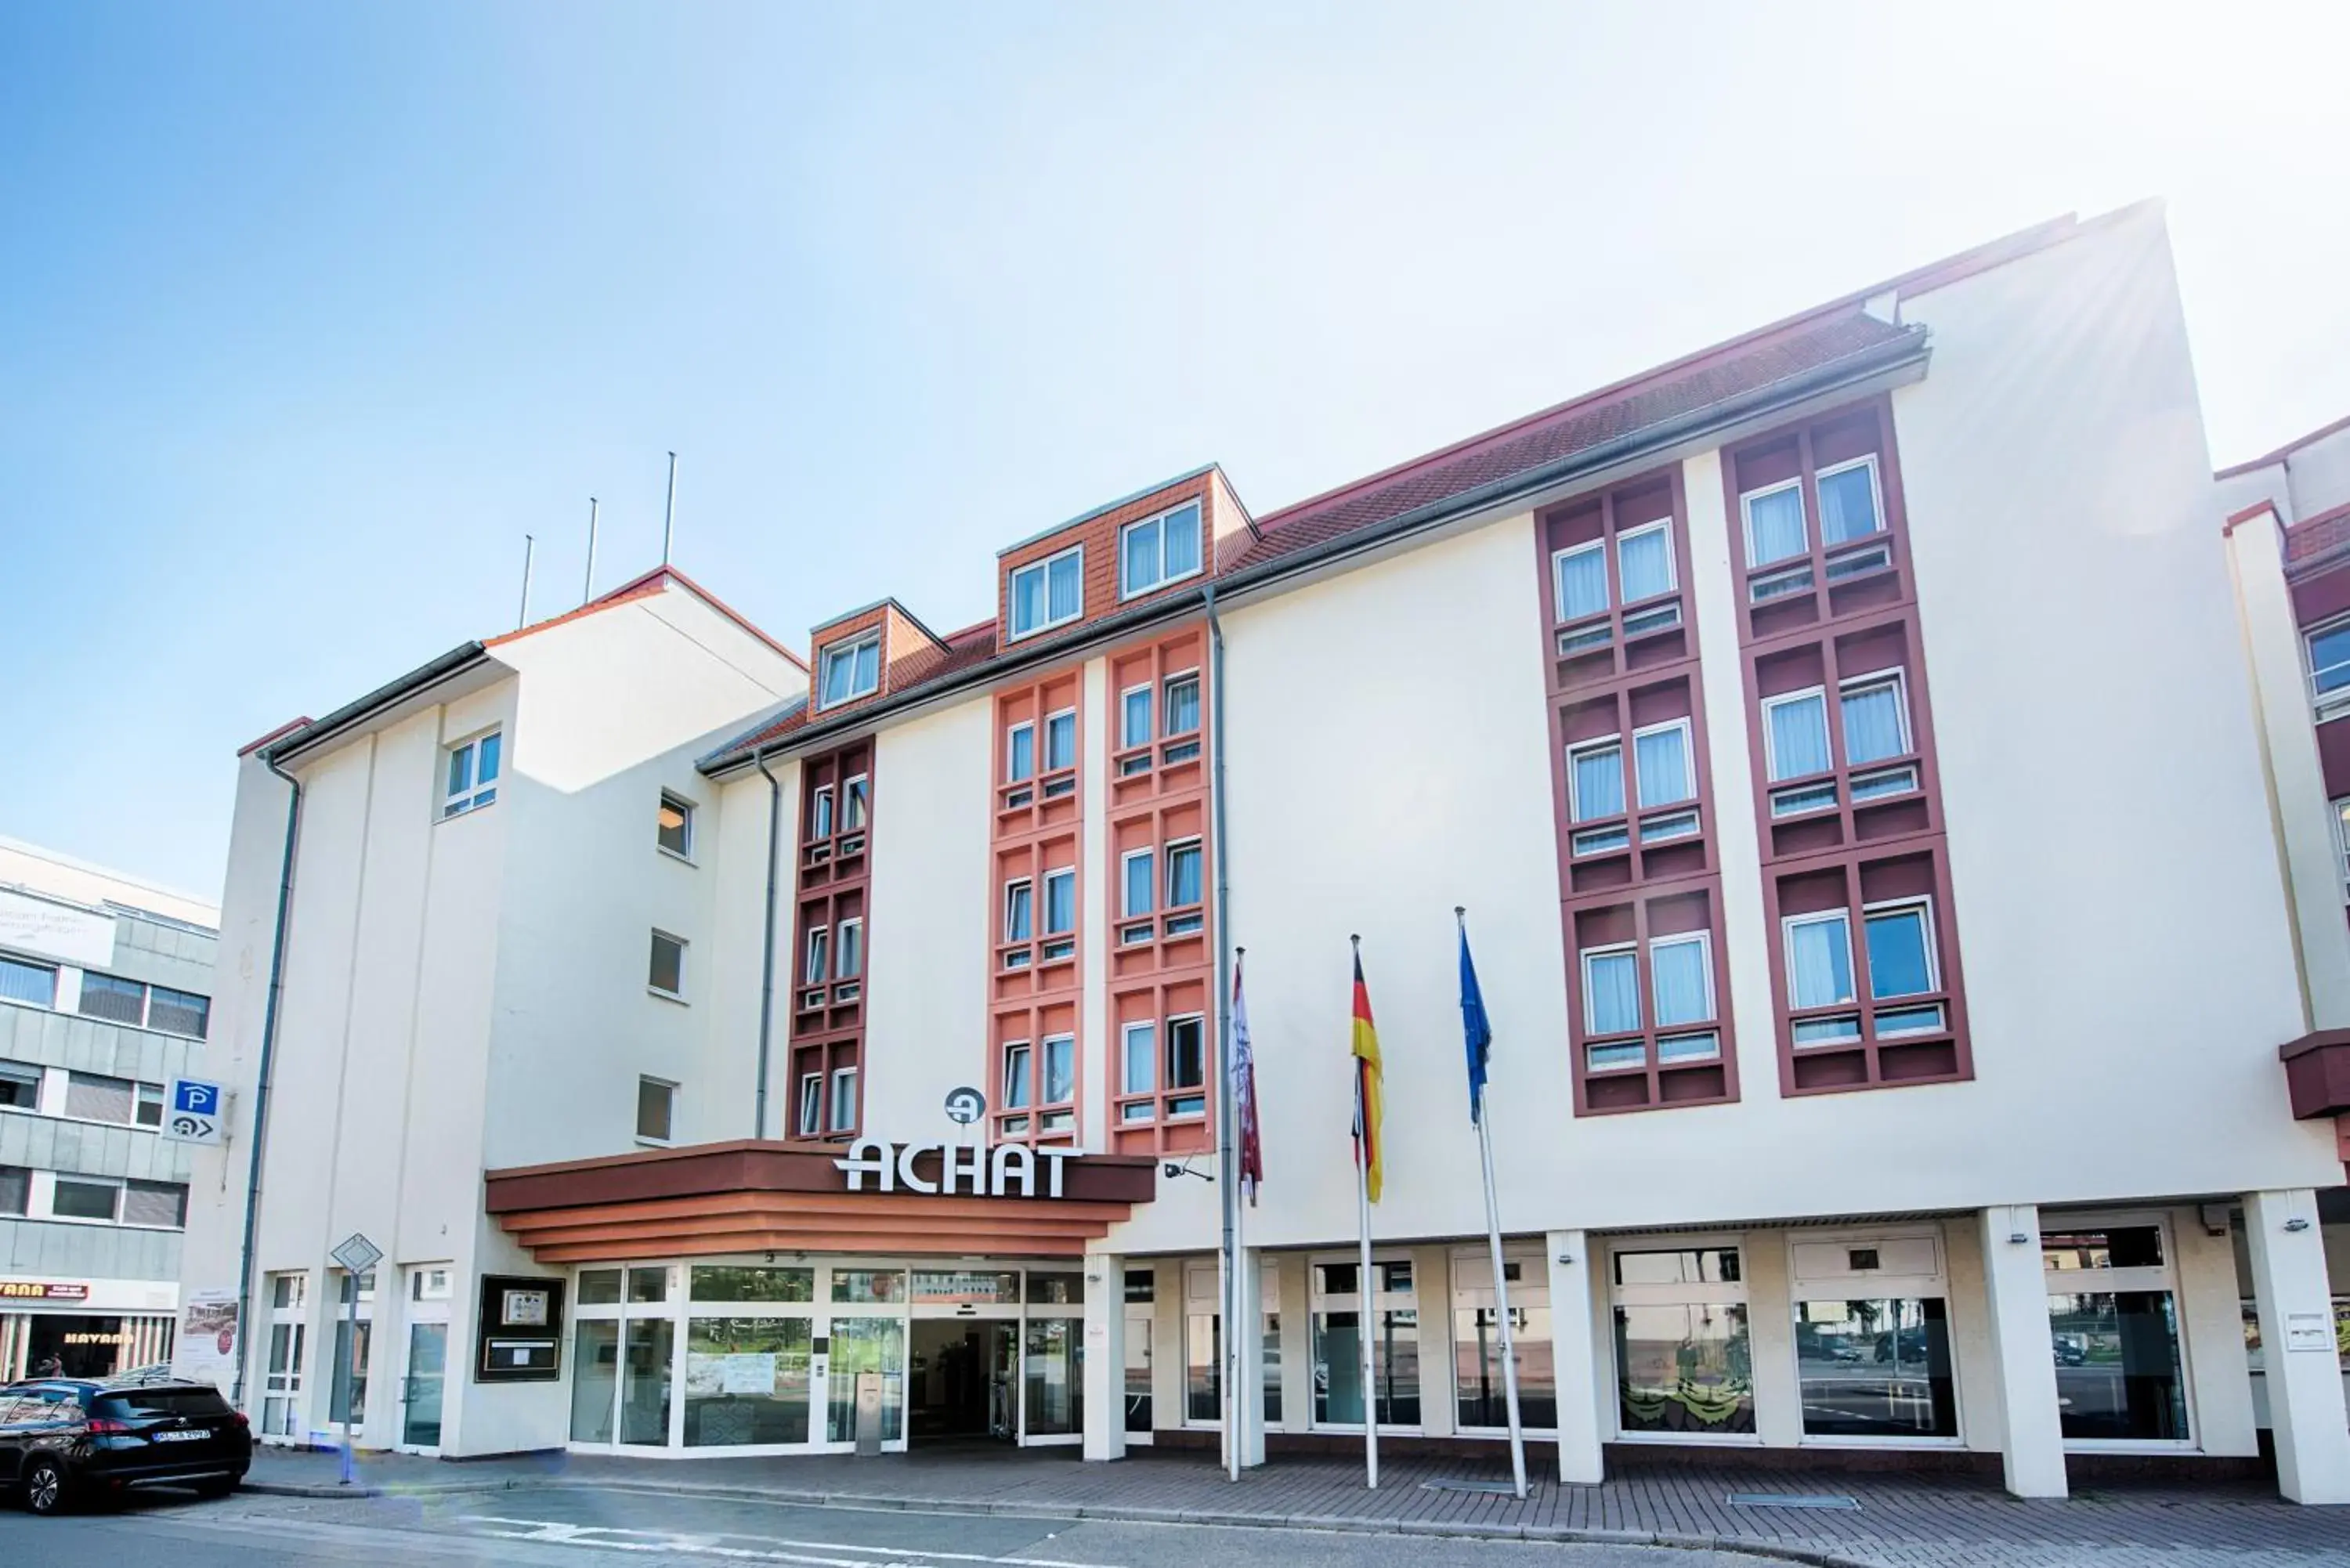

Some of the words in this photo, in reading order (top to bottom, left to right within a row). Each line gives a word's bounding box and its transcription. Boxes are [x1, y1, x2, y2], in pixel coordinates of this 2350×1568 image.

[188, 1091, 207, 1110] P
[833, 1139, 1085, 1198] ACHAT
[64, 1332, 134, 1344] HAVANA
